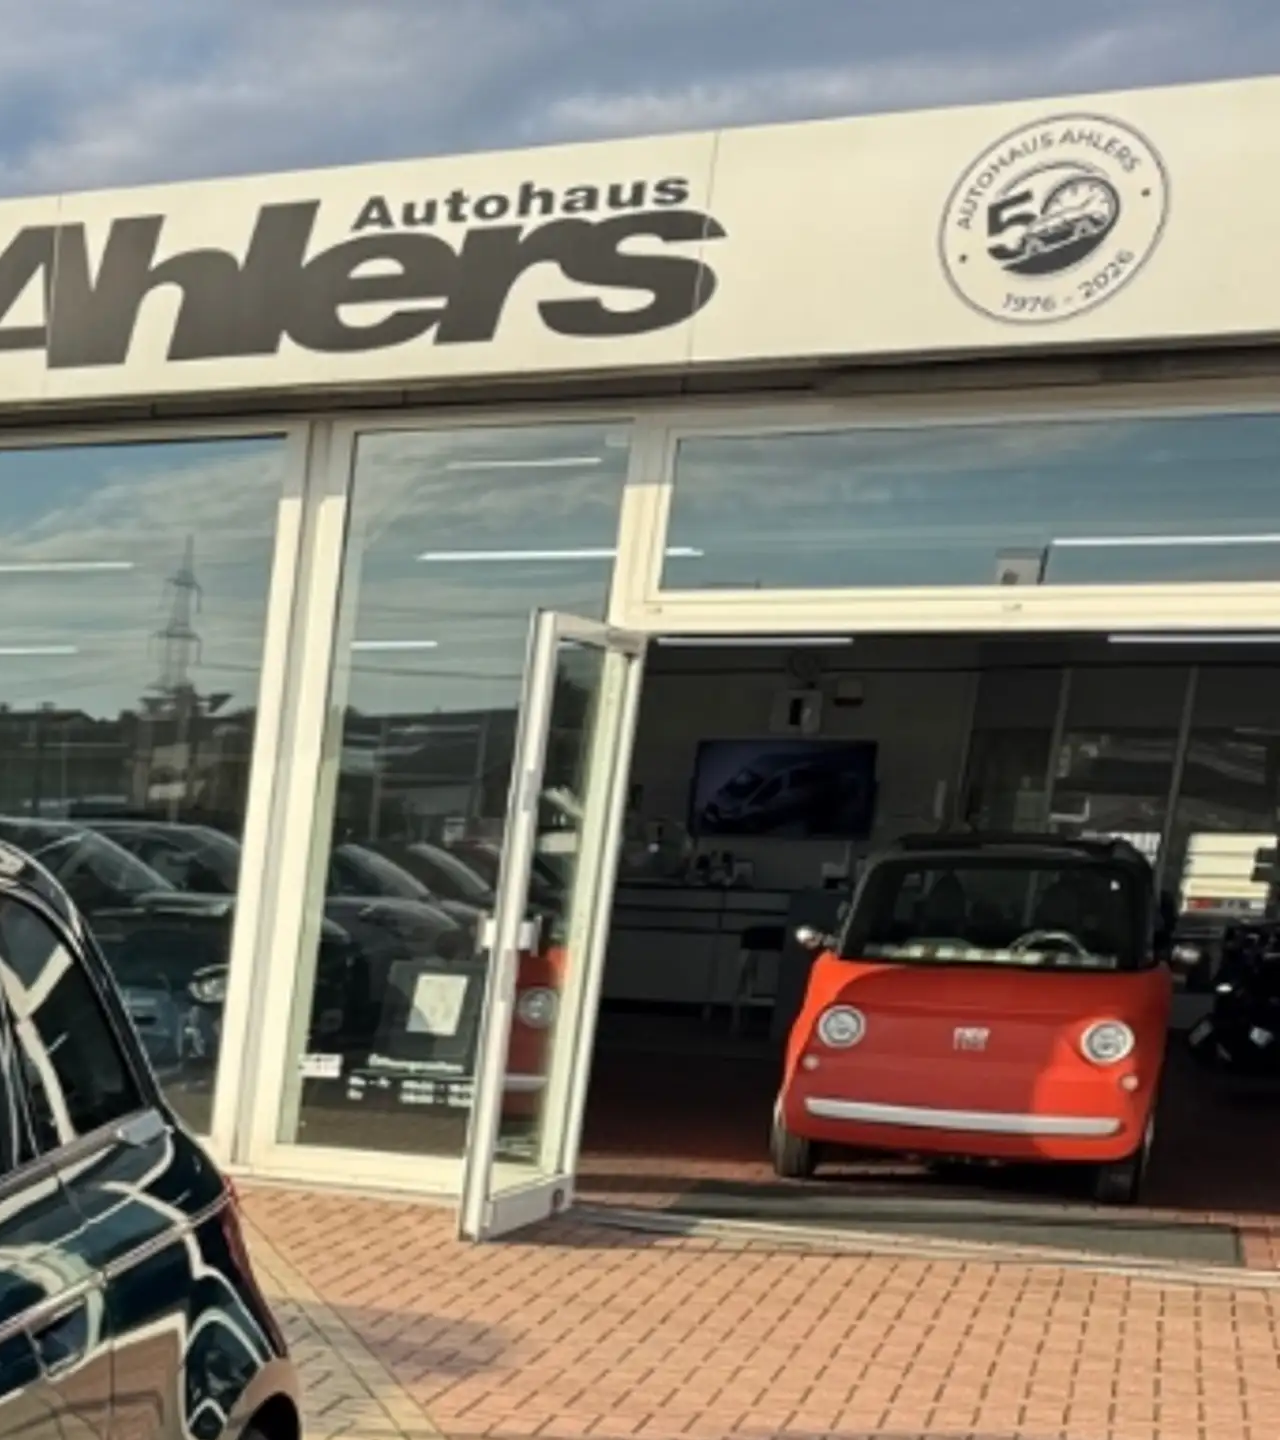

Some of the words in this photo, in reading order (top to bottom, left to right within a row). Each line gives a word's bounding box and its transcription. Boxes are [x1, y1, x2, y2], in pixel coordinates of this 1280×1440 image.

[351, 176, 691, 232] Autohaus
[956, 131, 1054, 231] AUTOHAUS
[1059, 127, 1143, 174] AHLERS
